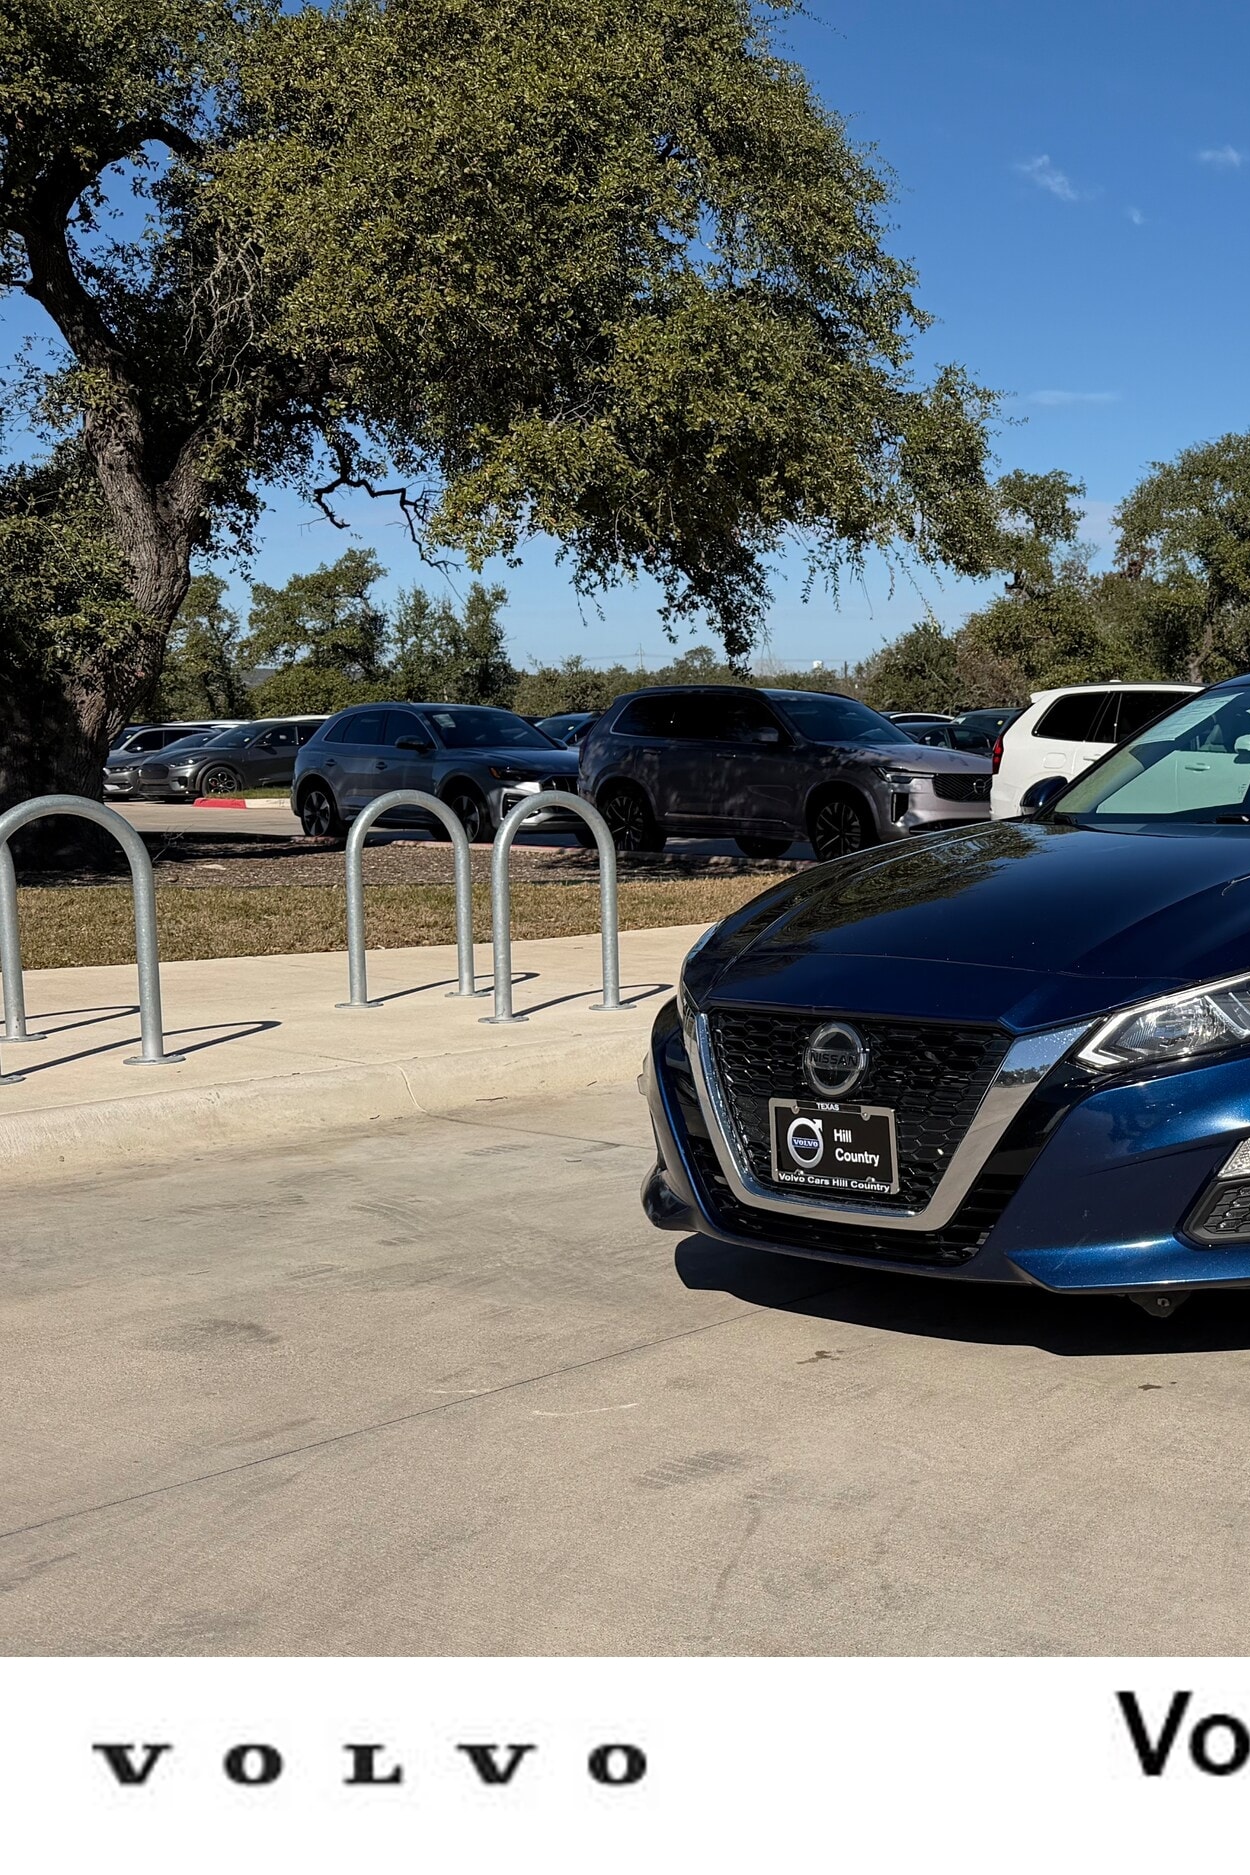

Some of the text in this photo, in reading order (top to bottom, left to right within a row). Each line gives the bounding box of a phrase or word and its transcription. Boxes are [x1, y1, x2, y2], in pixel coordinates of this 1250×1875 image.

[811, 1052, 858, 1067] NISSAN
[816, 1102, 840, 1112] TEXAS
[833, 1128, 852, 1143] Hill
[793, 1139, 819, 1148] VOLVO
[835, 1148, 880, 1167] Country
[779, 1172, 890, 1193] Volvo Cars Hill Country
